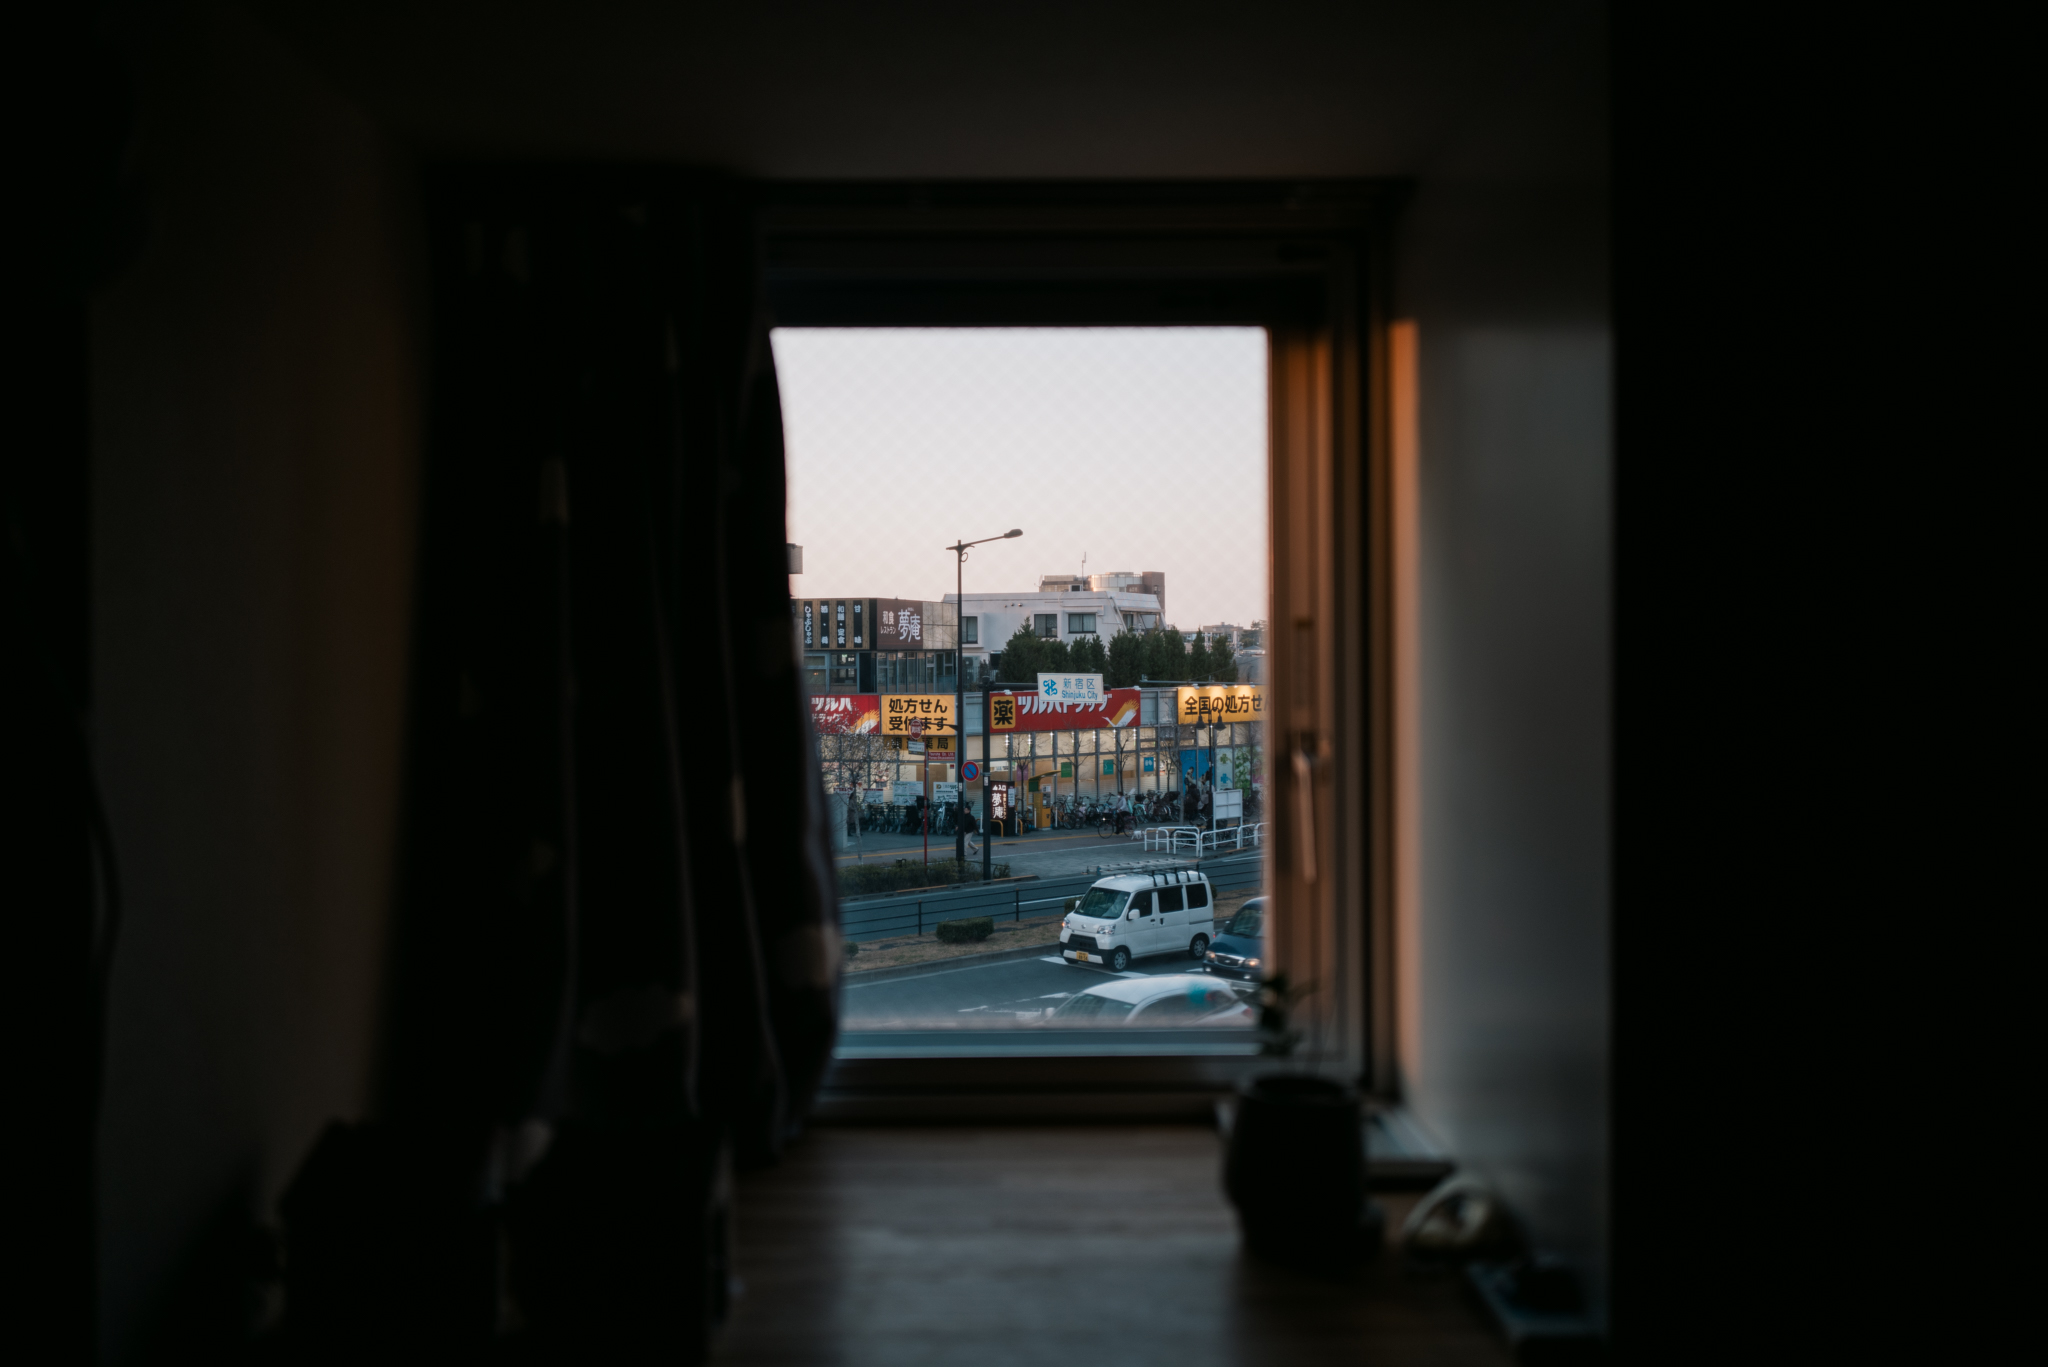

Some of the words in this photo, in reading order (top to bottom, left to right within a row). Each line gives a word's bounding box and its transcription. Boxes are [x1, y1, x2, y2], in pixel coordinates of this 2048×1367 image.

[882, 611, 894, 624] 和食
[880, 626, 897, 634] レストラン
[898, 609, 921, 642] 夢庵
[1063, 678, 1095, 689] 新宿区
[1062, 690, 1086, 700] Shinjuku
[1087, 690, 1098, 700] City
[811, 697, 852, 712] ツルハ
[889, 698, 947, 713] 処方せん
[994, 700, 1013, 725] 薬
[891, 737, 948, 749] 調薬局
